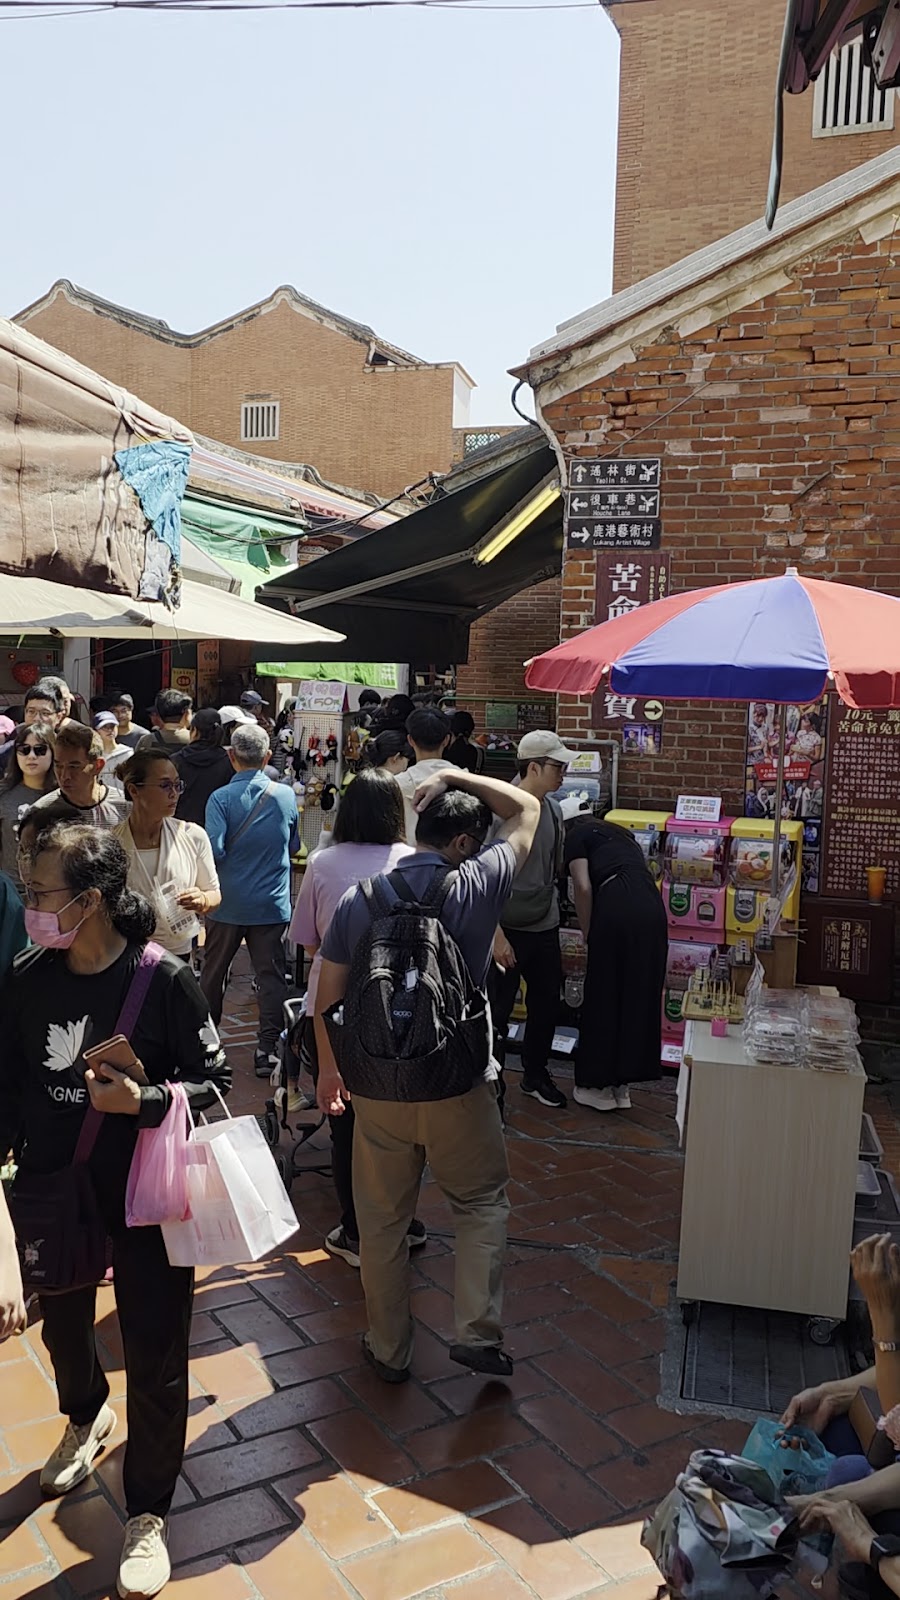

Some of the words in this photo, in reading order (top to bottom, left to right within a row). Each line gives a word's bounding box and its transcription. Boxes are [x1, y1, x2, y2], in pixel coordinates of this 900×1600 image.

[590, 493, 636, 506] 後車巷
[593, 524, 653, 538] 鹿港藝術村
